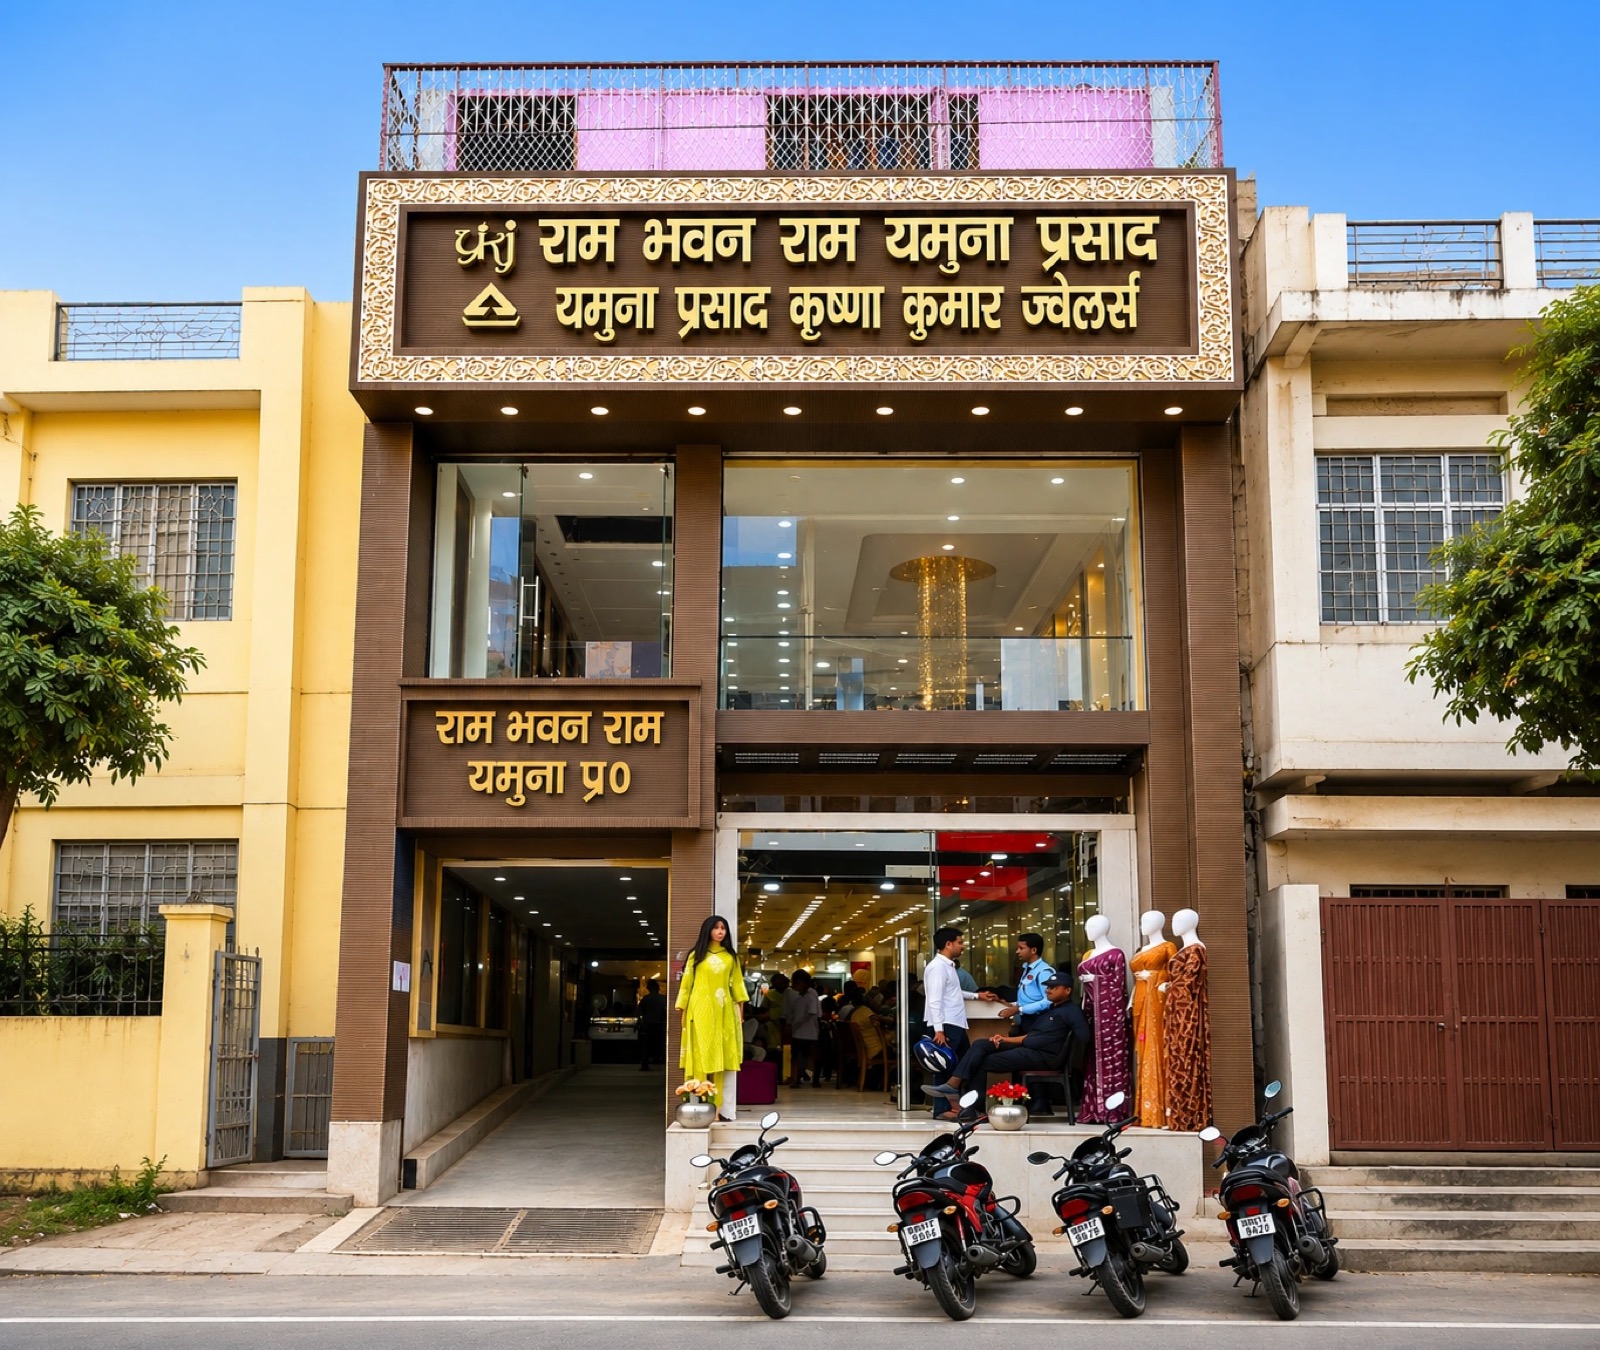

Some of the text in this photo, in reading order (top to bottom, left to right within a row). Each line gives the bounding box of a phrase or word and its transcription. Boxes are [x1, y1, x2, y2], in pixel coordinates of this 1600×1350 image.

[539, 216, 1160, 274] राम भवन राम यमुना प्रसाद
[556, 271, 1141, 341] यमुना प्रसाद कृष्णा कुमार ज्वेलर्स
[436, 711, 665, 744] राम भवन राम
[468, 761, 567, 806] यमुना
